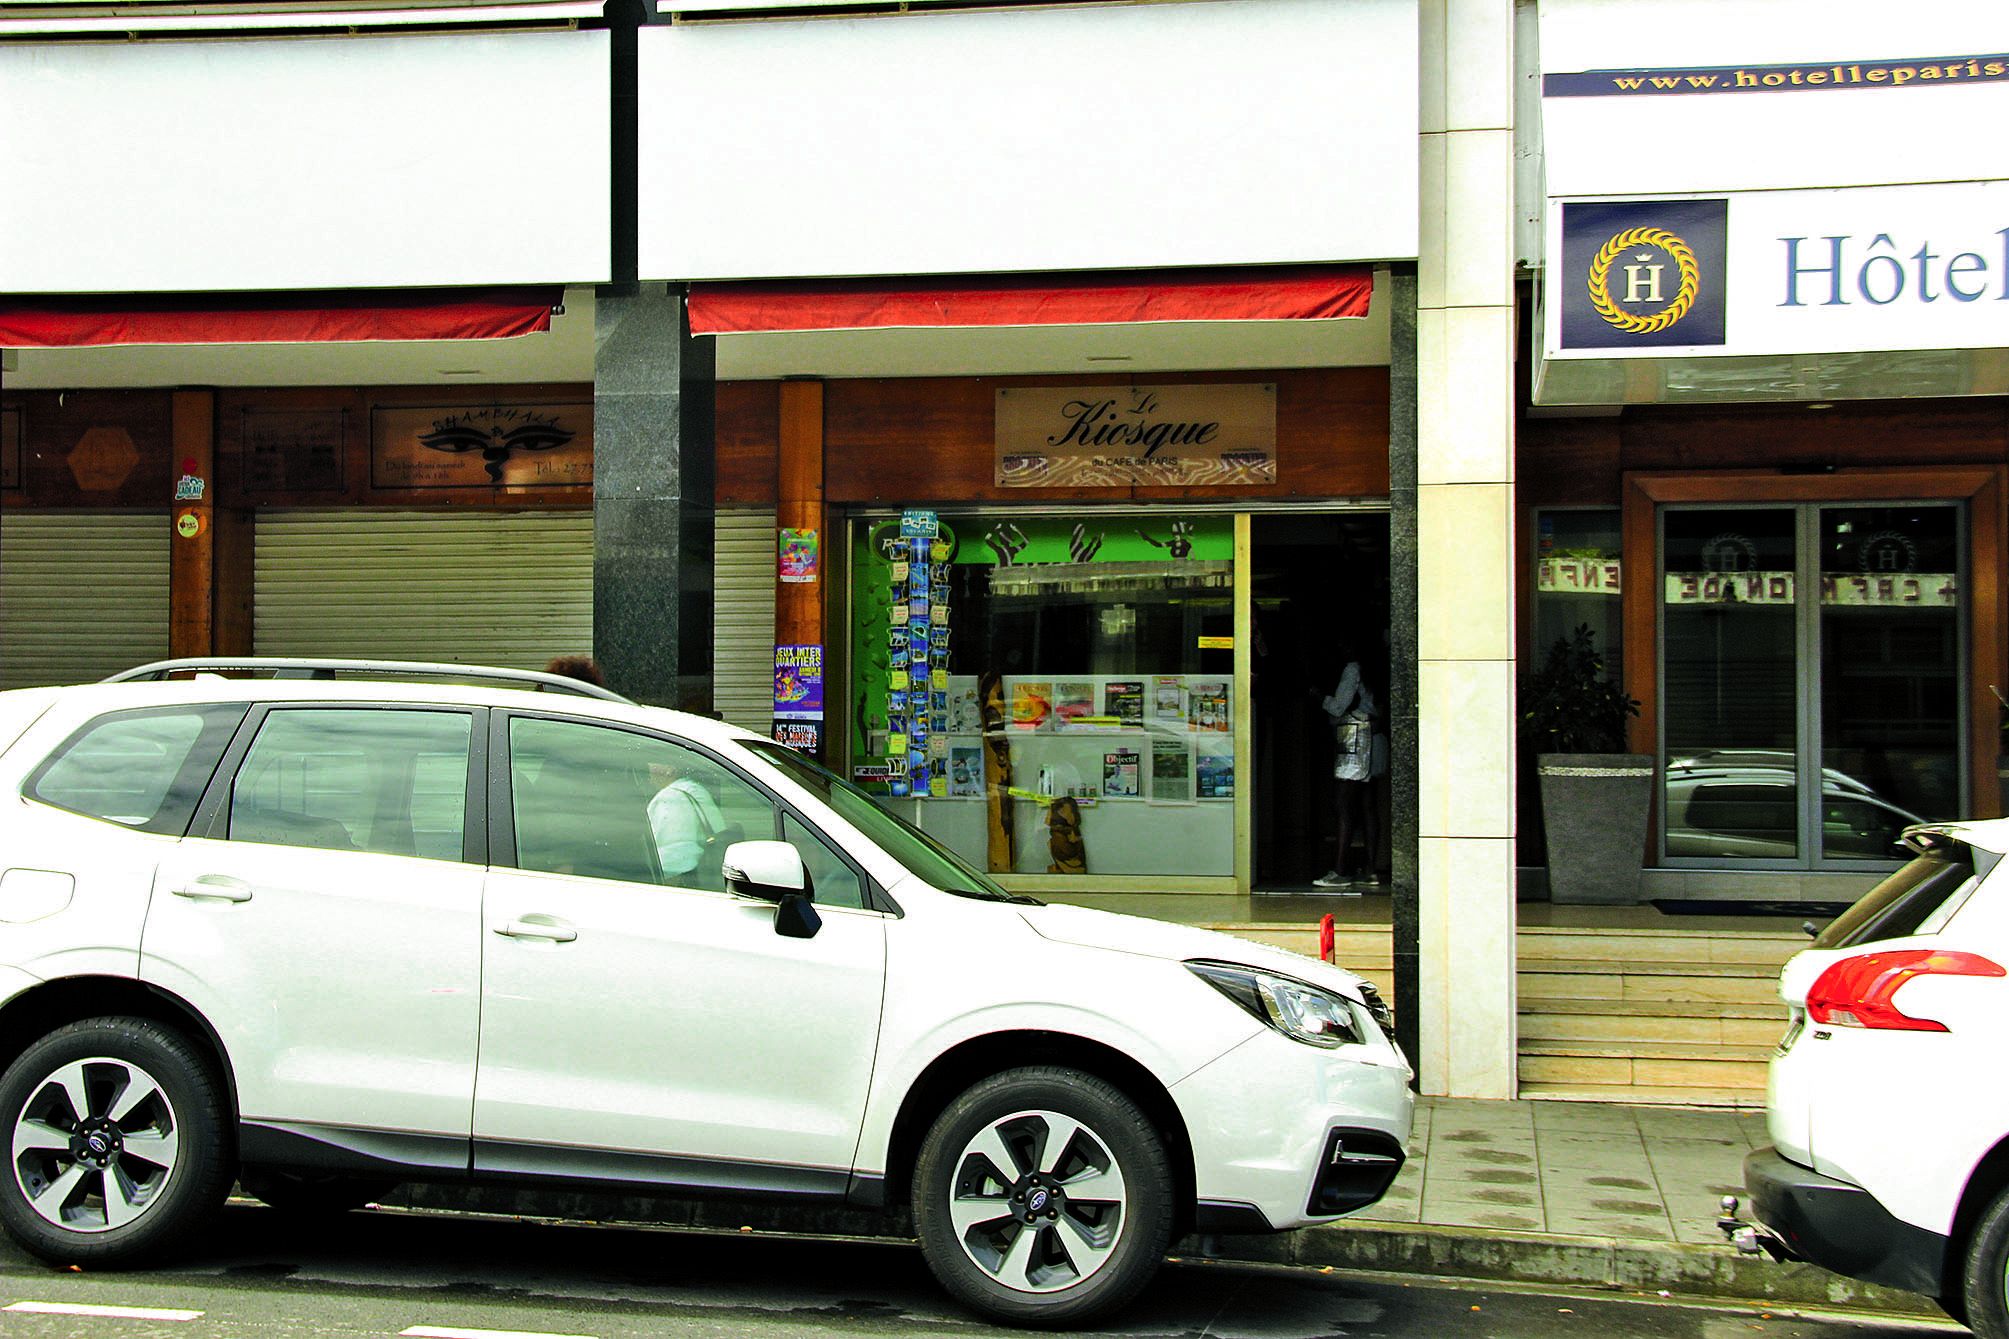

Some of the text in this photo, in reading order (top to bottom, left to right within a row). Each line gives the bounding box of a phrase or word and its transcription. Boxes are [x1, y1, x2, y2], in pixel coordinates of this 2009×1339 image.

[1613, 60, 2009, 92] www.hotelleparis
[1776, 224, 2009, 307] Hôtel
[1623, 263, 1665, 303] H
[1127, 391, 1159, 415] Le
[1047, 398, 1221, 459] Kiosque
[1148, 456, 1179, 466] PARIS
[796, 647, 821, 658] INTER
[776, 656, 821, 668] QUARTIERS
[788, 724, 816, 733] FESTIVAL
[1106, 754, 1138, 766] Objectif
